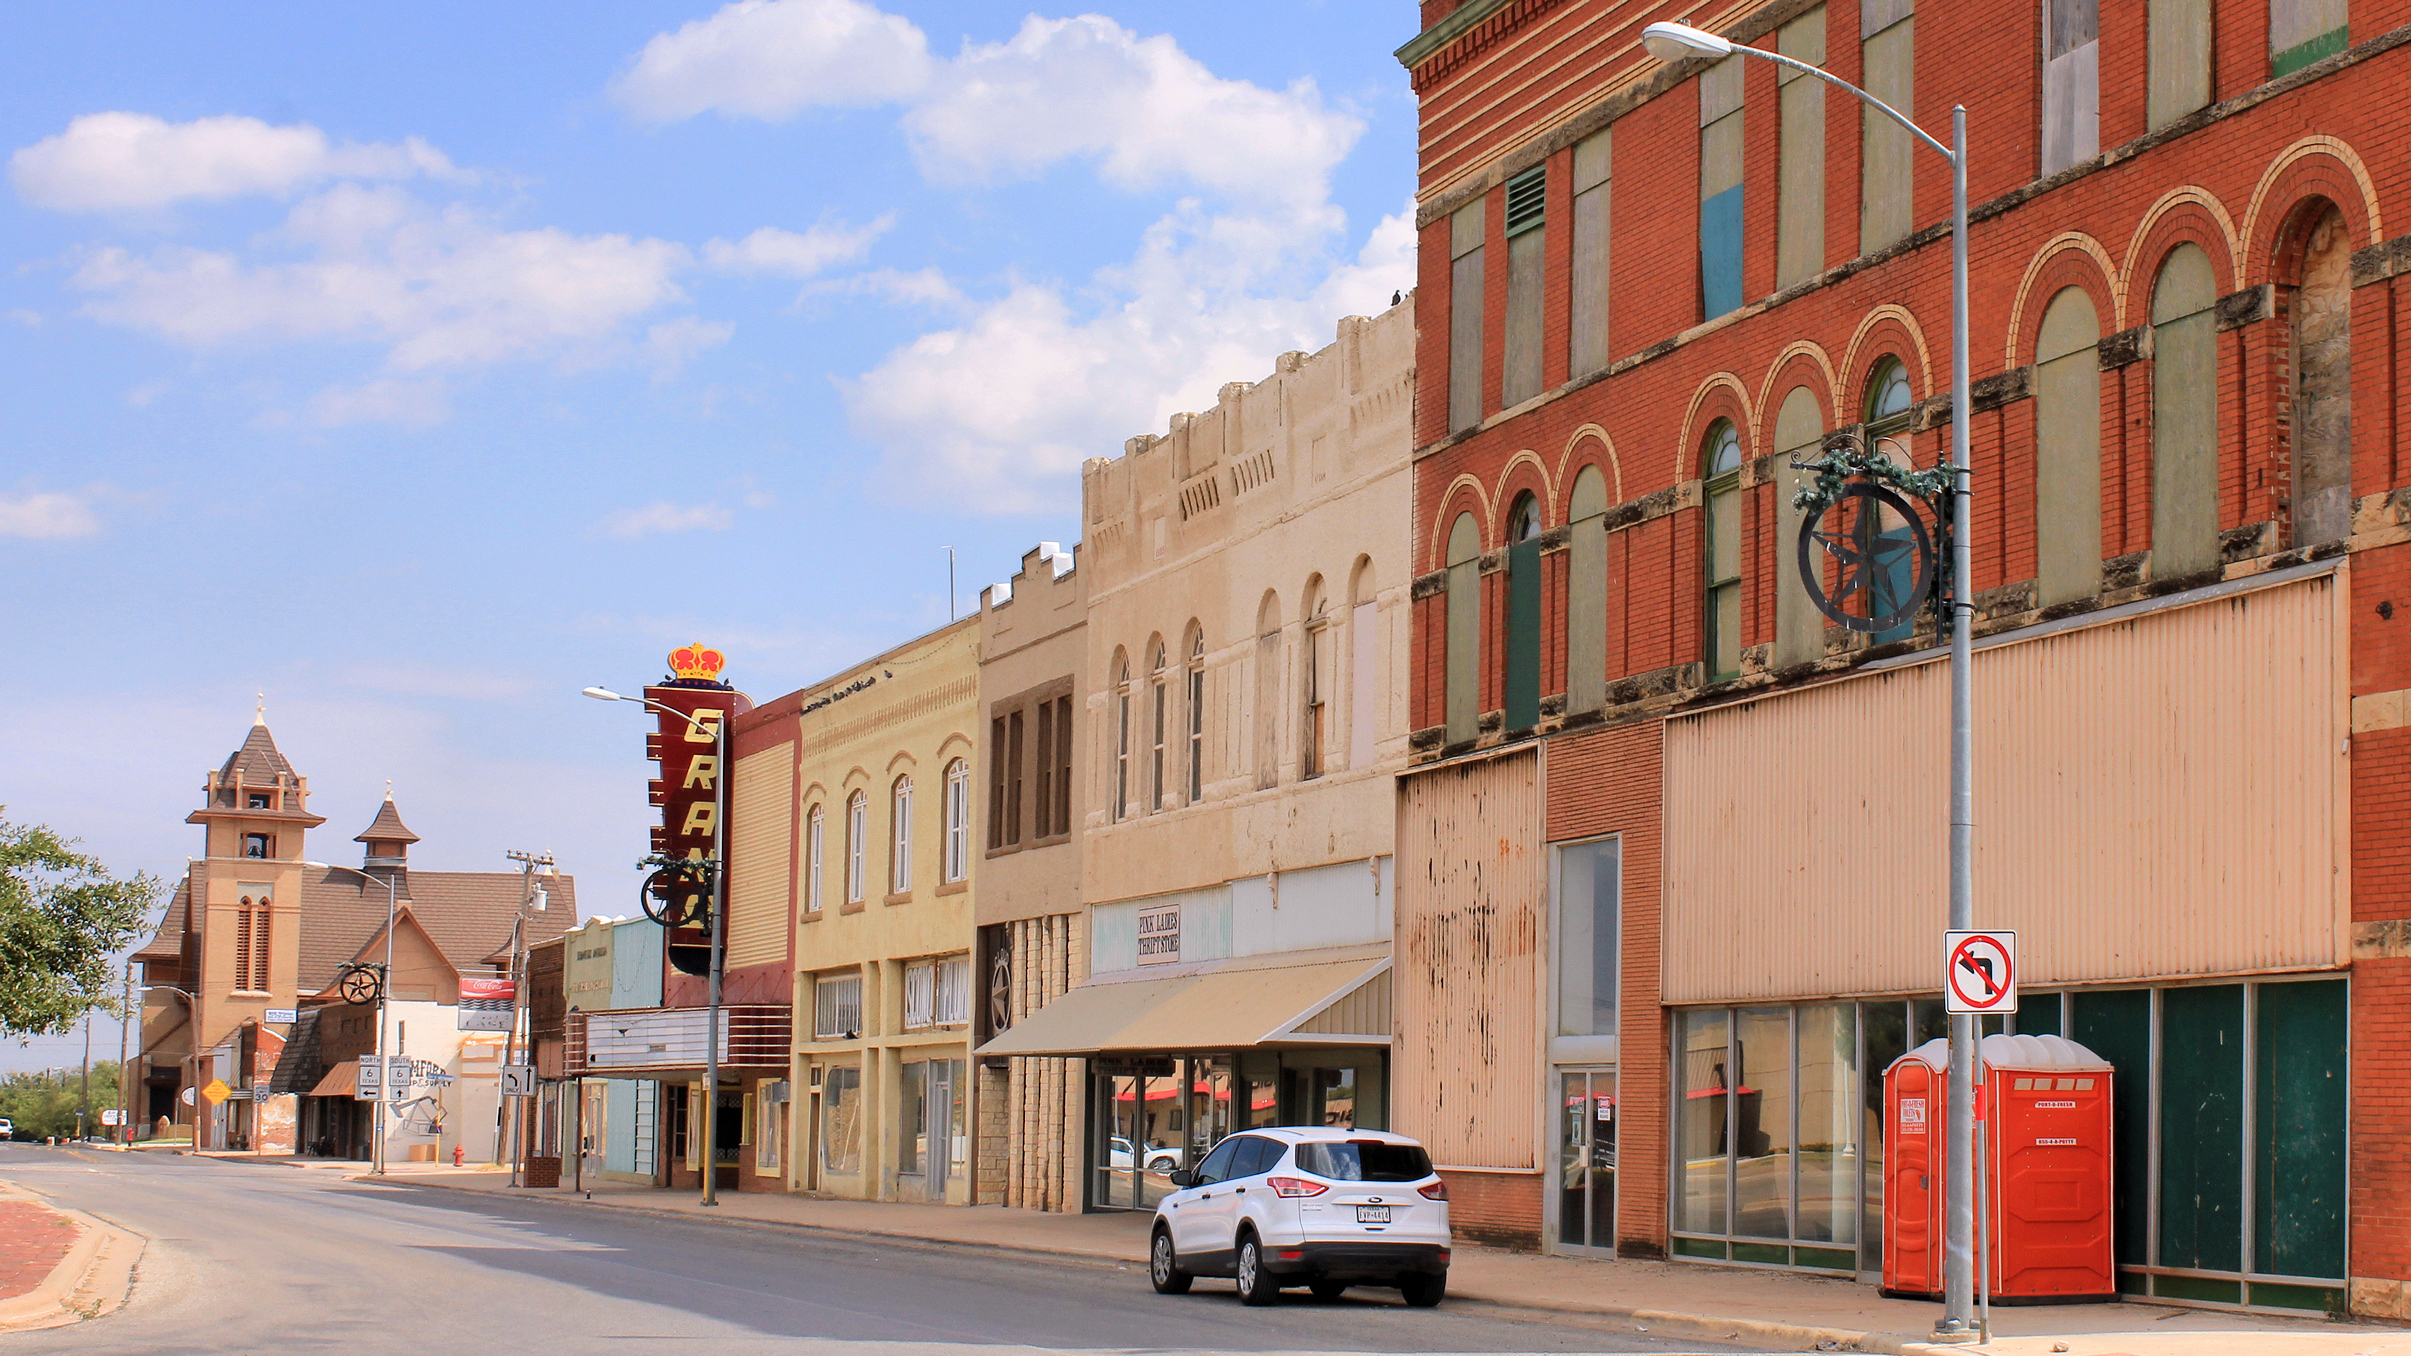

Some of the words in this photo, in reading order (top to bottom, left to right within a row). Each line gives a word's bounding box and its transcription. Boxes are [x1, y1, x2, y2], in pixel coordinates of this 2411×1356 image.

[1139, 915, 1154, 934] PINK
[1156, 911, 1178, 931] LADIES
[1138, 936, 1160, 955] THRIFT
[1160, 933, 1178, 953] STORE
[366, 1069, 374, 1077] 6
[396, 1069, 404, 1077] 6
[411, 1060, 446, 1077] MFORD
